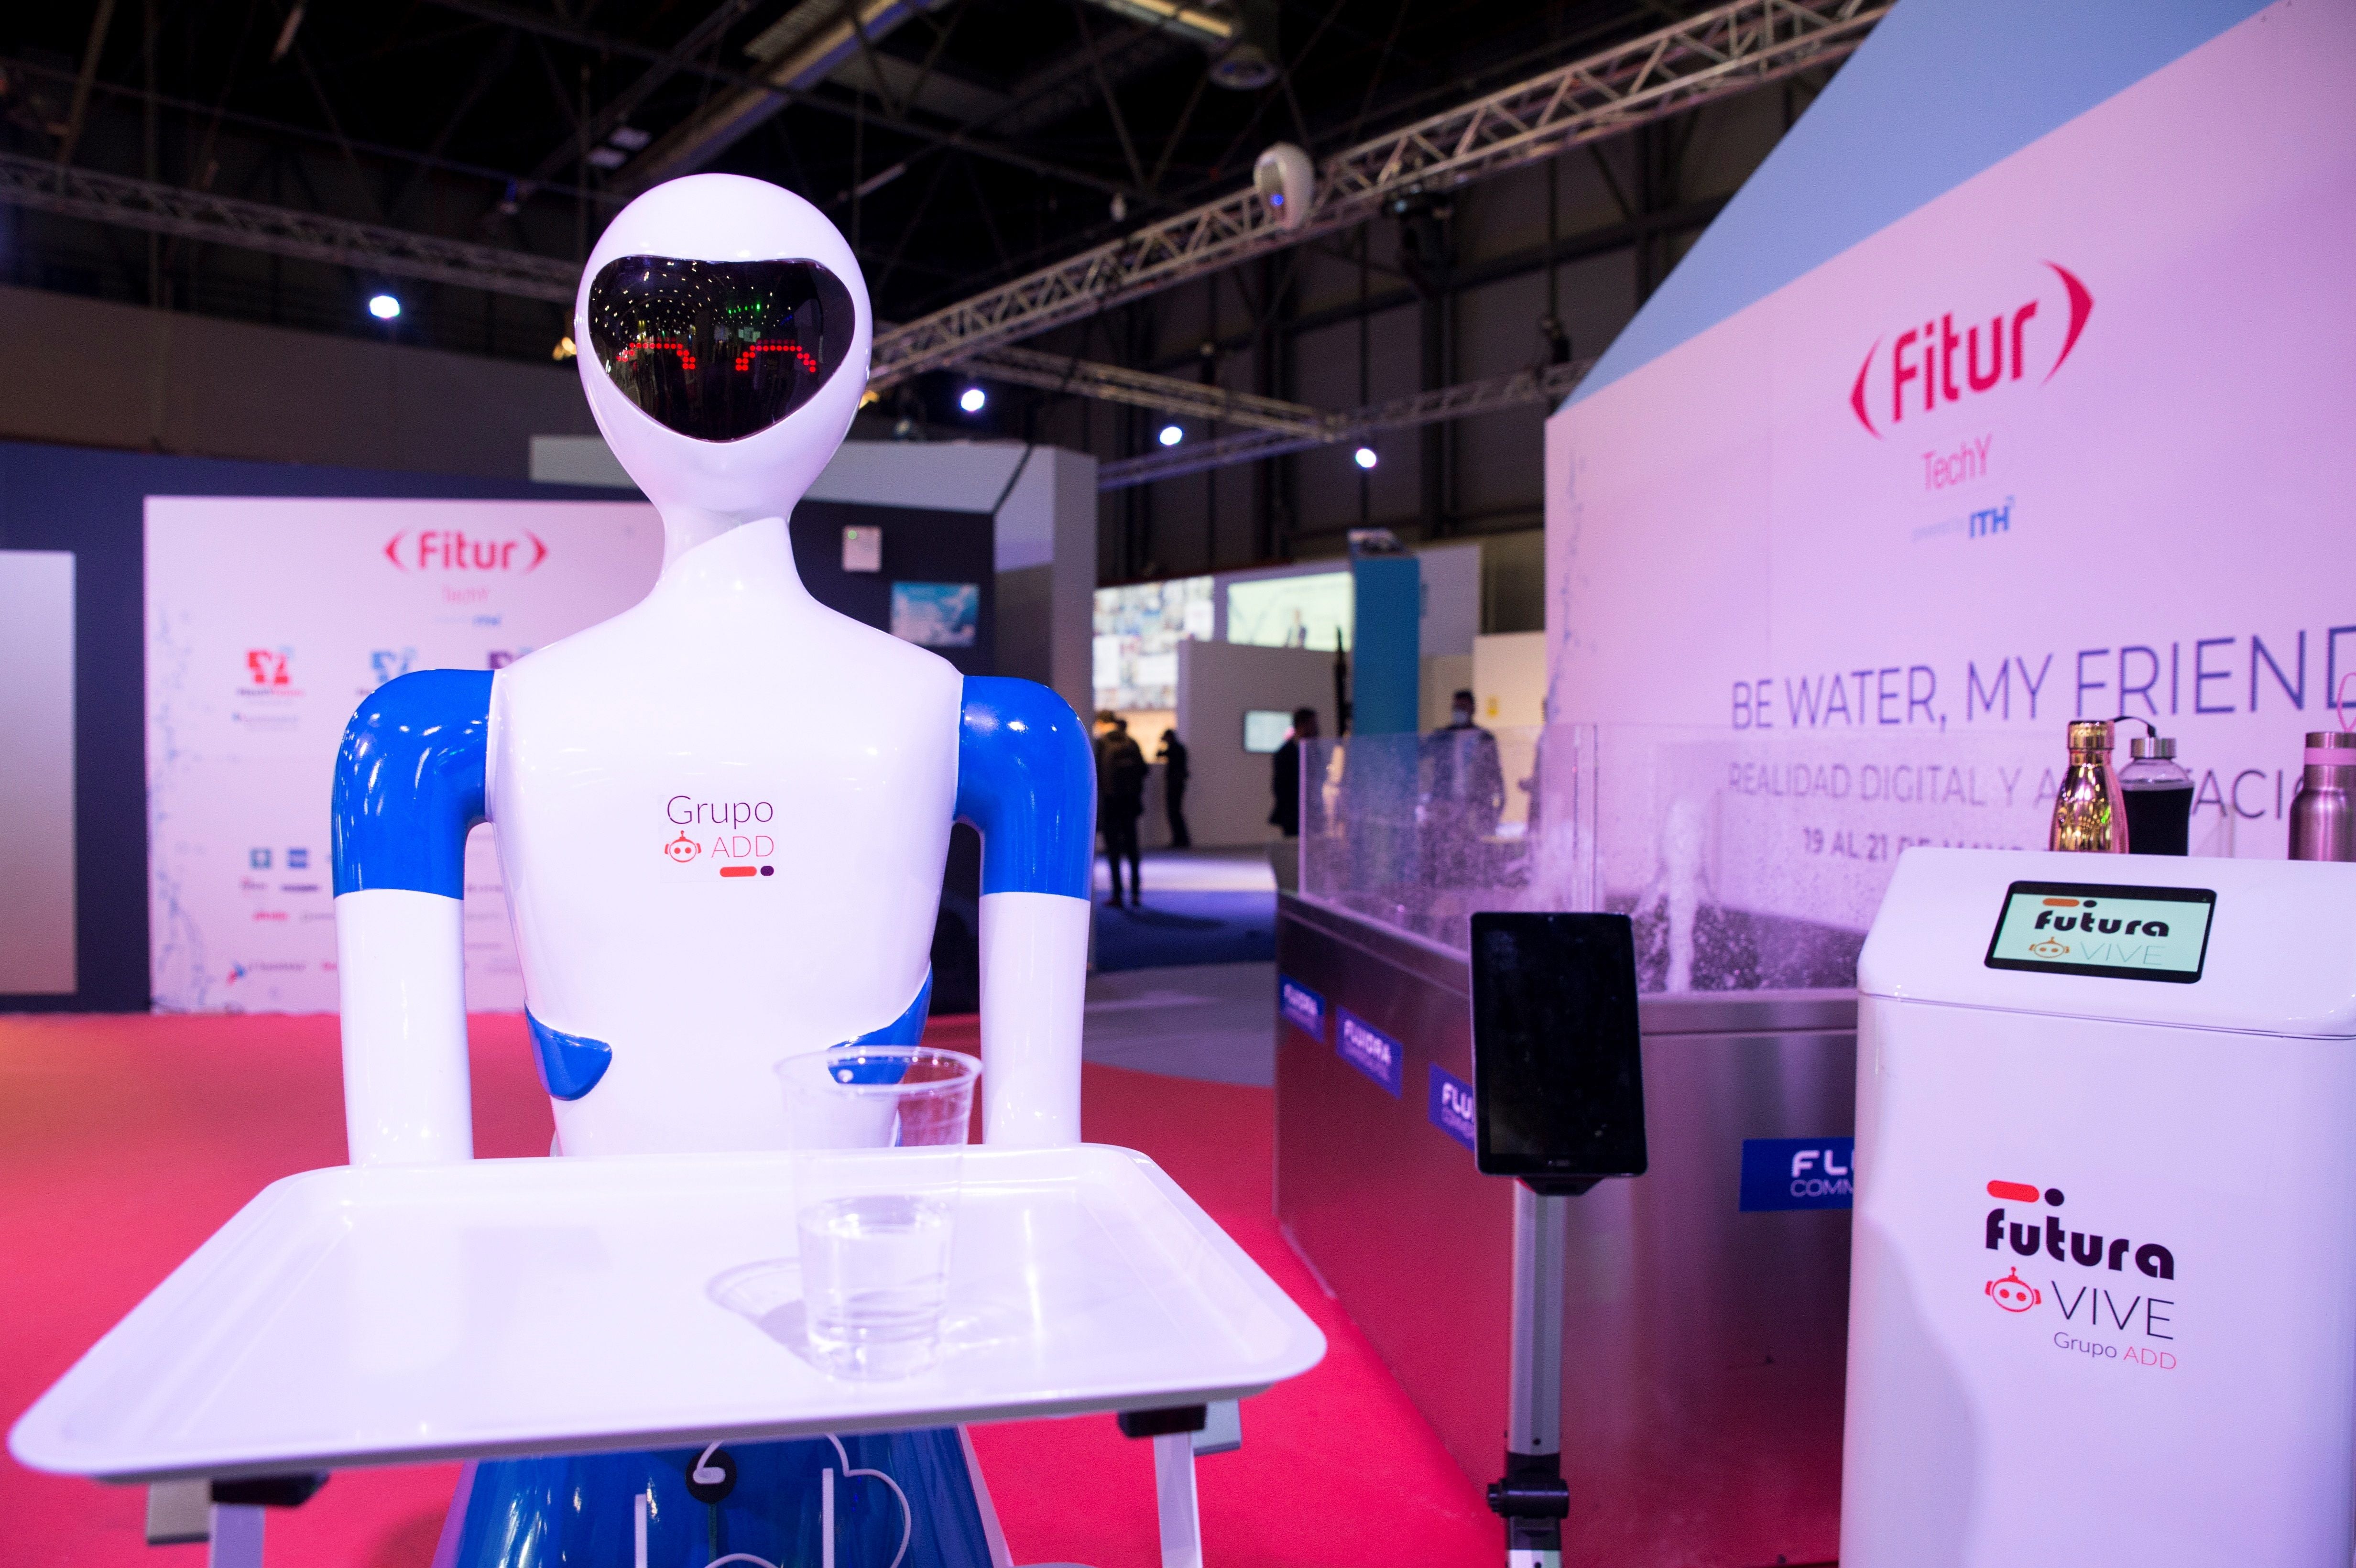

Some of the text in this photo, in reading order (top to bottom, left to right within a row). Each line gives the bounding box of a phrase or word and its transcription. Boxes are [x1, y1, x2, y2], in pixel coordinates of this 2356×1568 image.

[1892, 300, 2038, 423] Fitur
[1922, 434, 1993, 490] TechY
[418, 530, 519, 570] Fitur
[1732, 678, 1773, 730] BE
[1785, 664, 1947, 732] WATER,
[1967, 654, 2052, 721] MY
[1728, 761, 1853, 801] REALIDAD
[1861, 763, 1987, 808] DIGITAL
[1998, 766, 2022, 808] Y
[667, 795, 773, 829] Grupo
[711, 835, 774, 858] ADD
[1831, 830, 1861, 859] AL
[2034, 910, 2170, 937] futura
[2080, 941, 2166, 965] VIVE
[1791, 1149, 1854, 1178] FL
[1985, 1208, 2174, 1280] futura
[2051, 1280, 2174, 1340] VIVE
[2054, 1331, 2177, 1370] Grupo ADD
